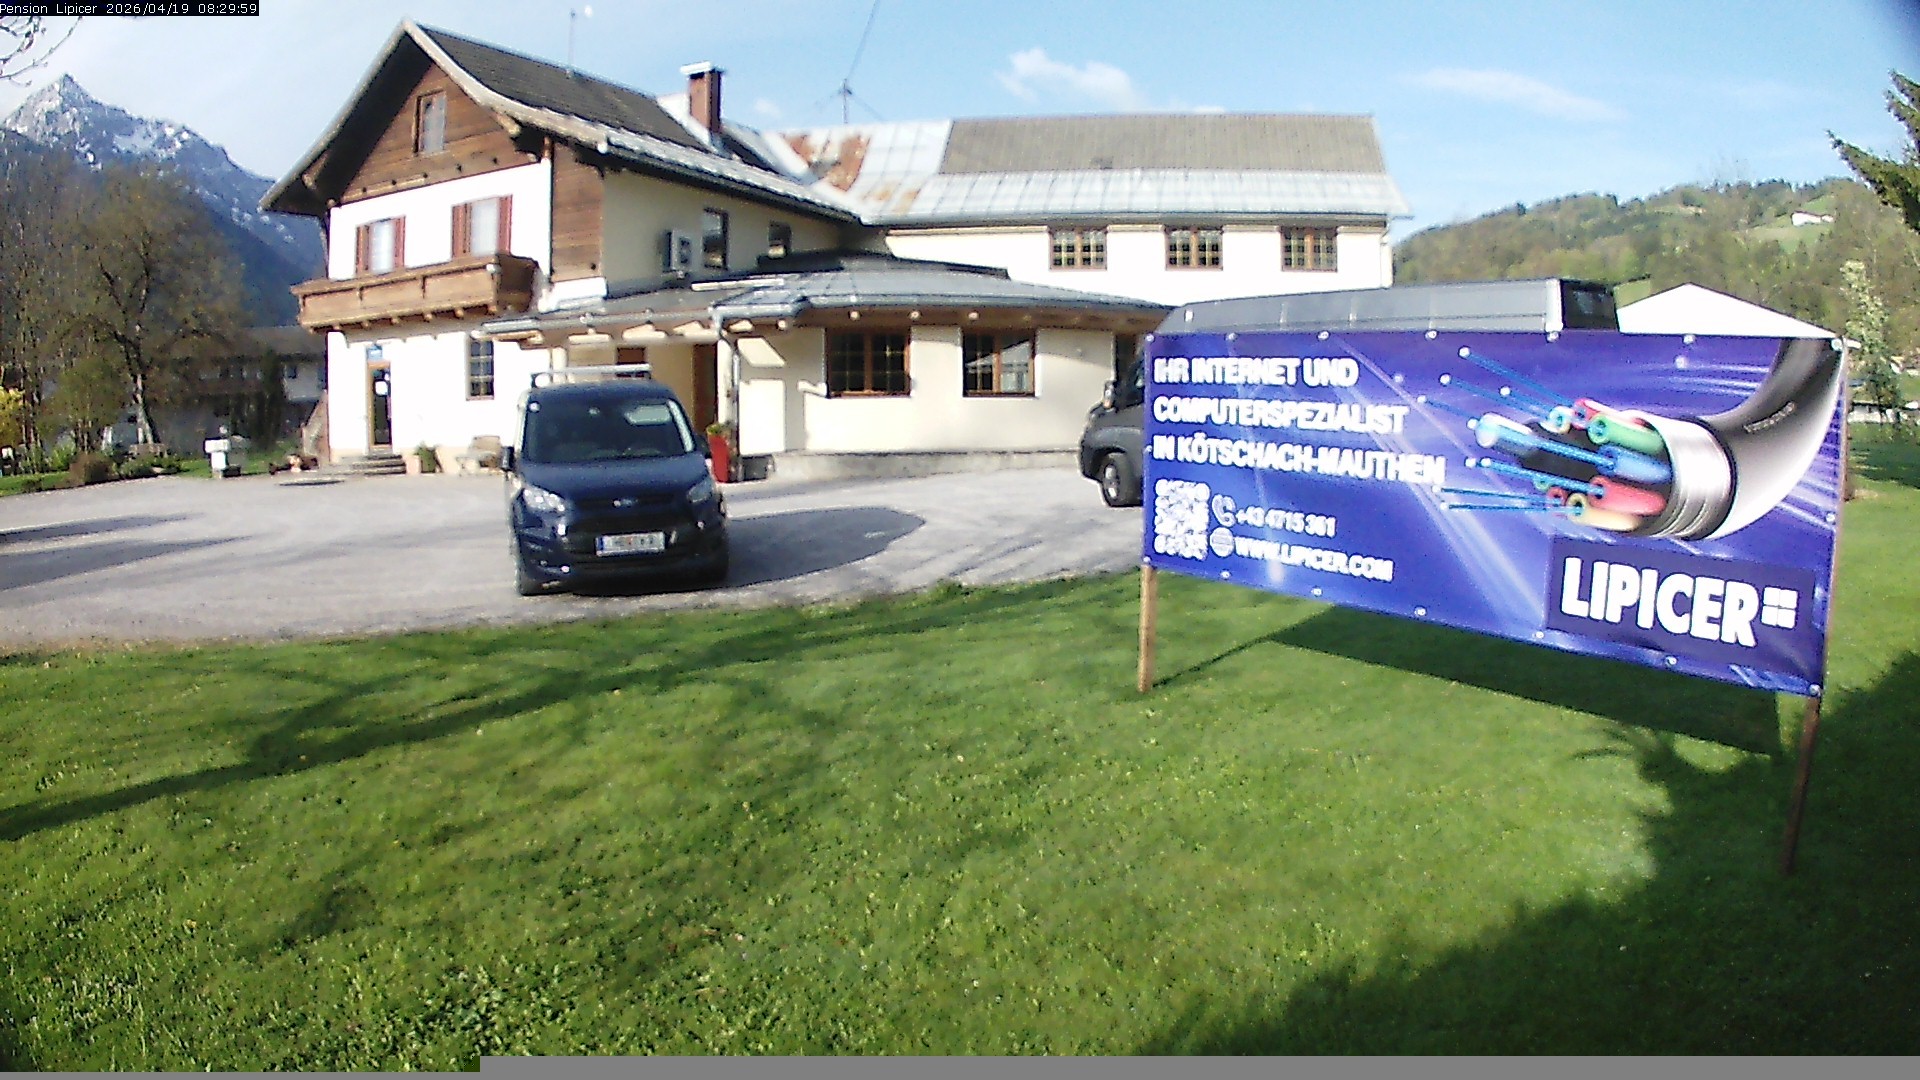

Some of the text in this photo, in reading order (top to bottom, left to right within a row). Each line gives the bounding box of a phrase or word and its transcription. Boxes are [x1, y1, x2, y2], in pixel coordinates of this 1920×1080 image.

[1153, 358, 1359, 386] IHR INTERNET UND
[1153, 397, 1409, 433] COMPUTERSPEZIALIST
[1153, 432, 1446, 483] IN KÖTSCHACH-MAUTHEN
[1561, 557, 1758, 648] LIPICER
